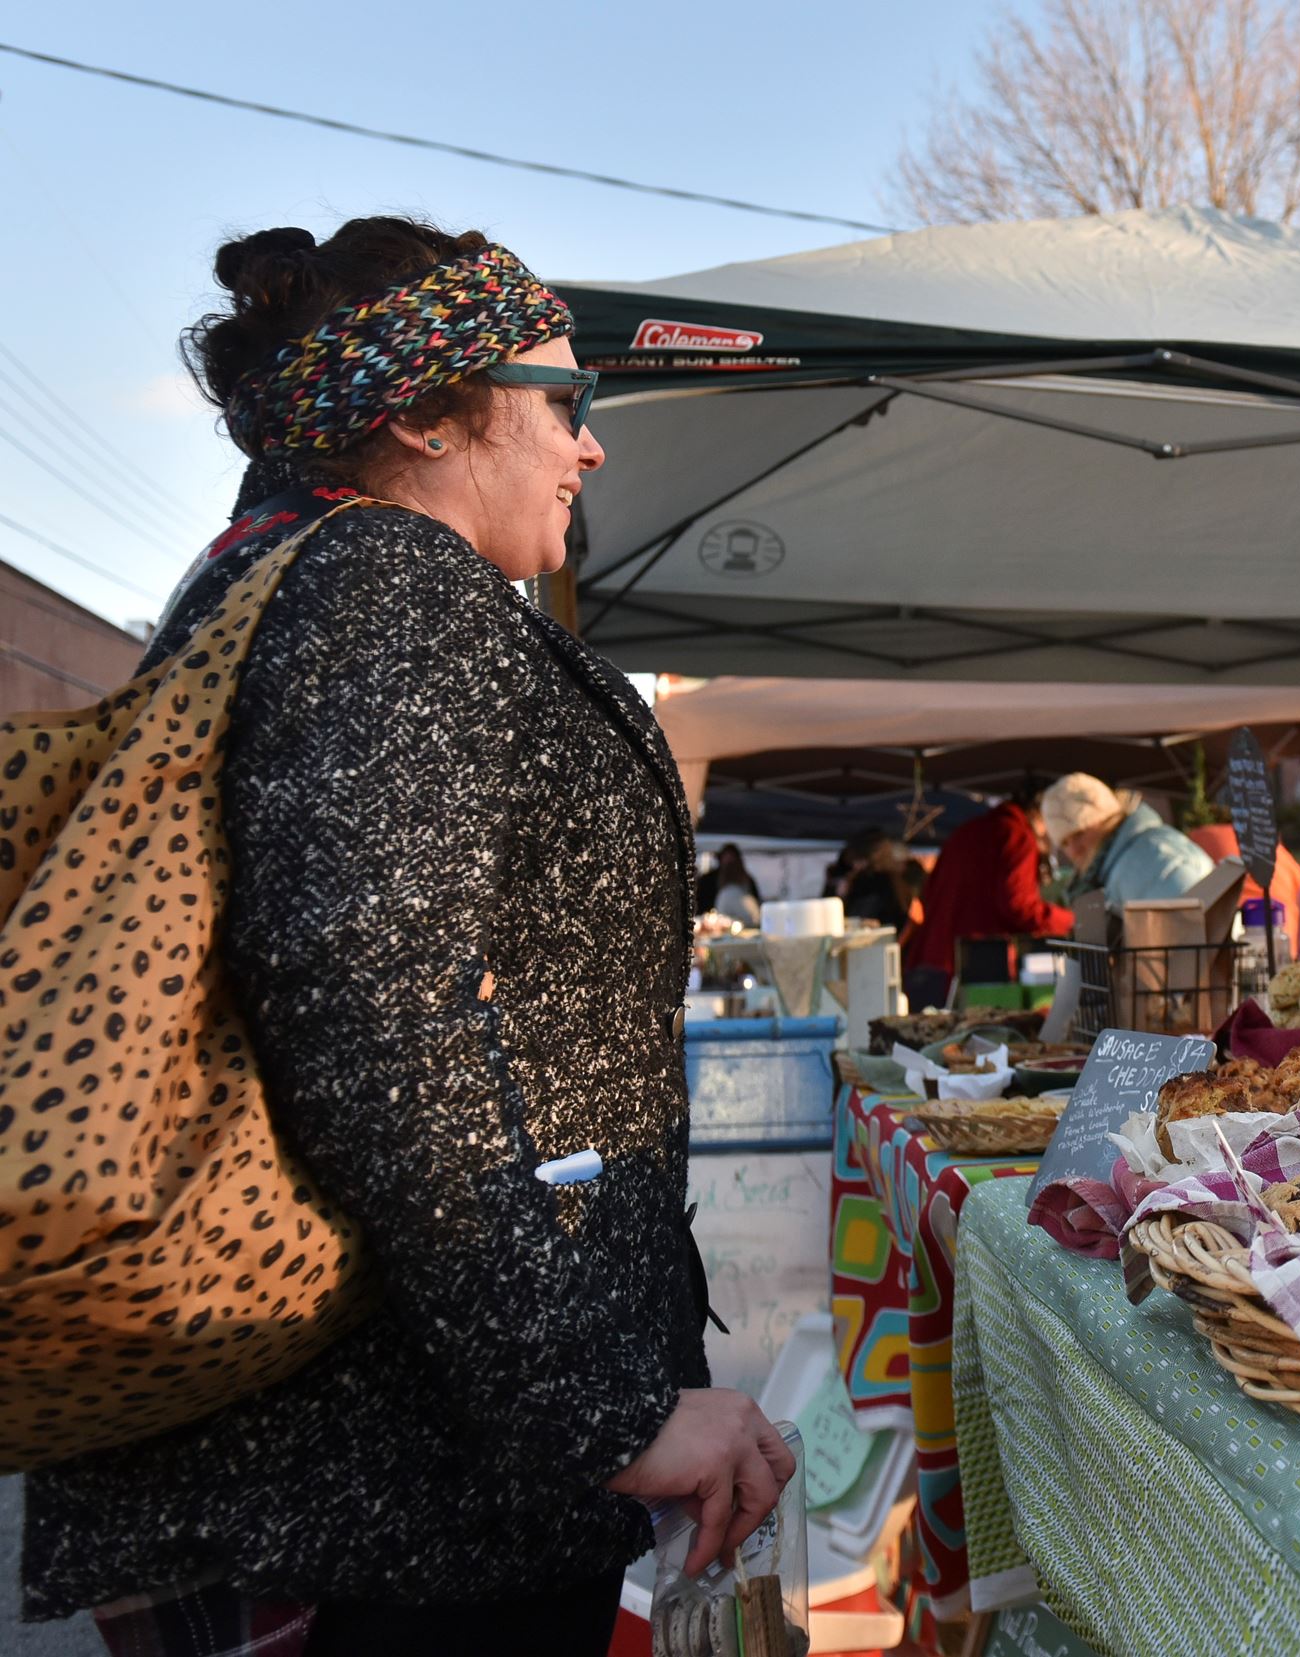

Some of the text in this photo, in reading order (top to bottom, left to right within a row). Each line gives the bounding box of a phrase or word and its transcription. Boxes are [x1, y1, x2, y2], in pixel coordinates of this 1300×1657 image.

[643, 324, 737, 350] Coleman
[672, 357, 713, 367] SUN
[718, 356, 800, 366] SHELTER
[1097, 1034, 1162, 1063] SAUSAGE
